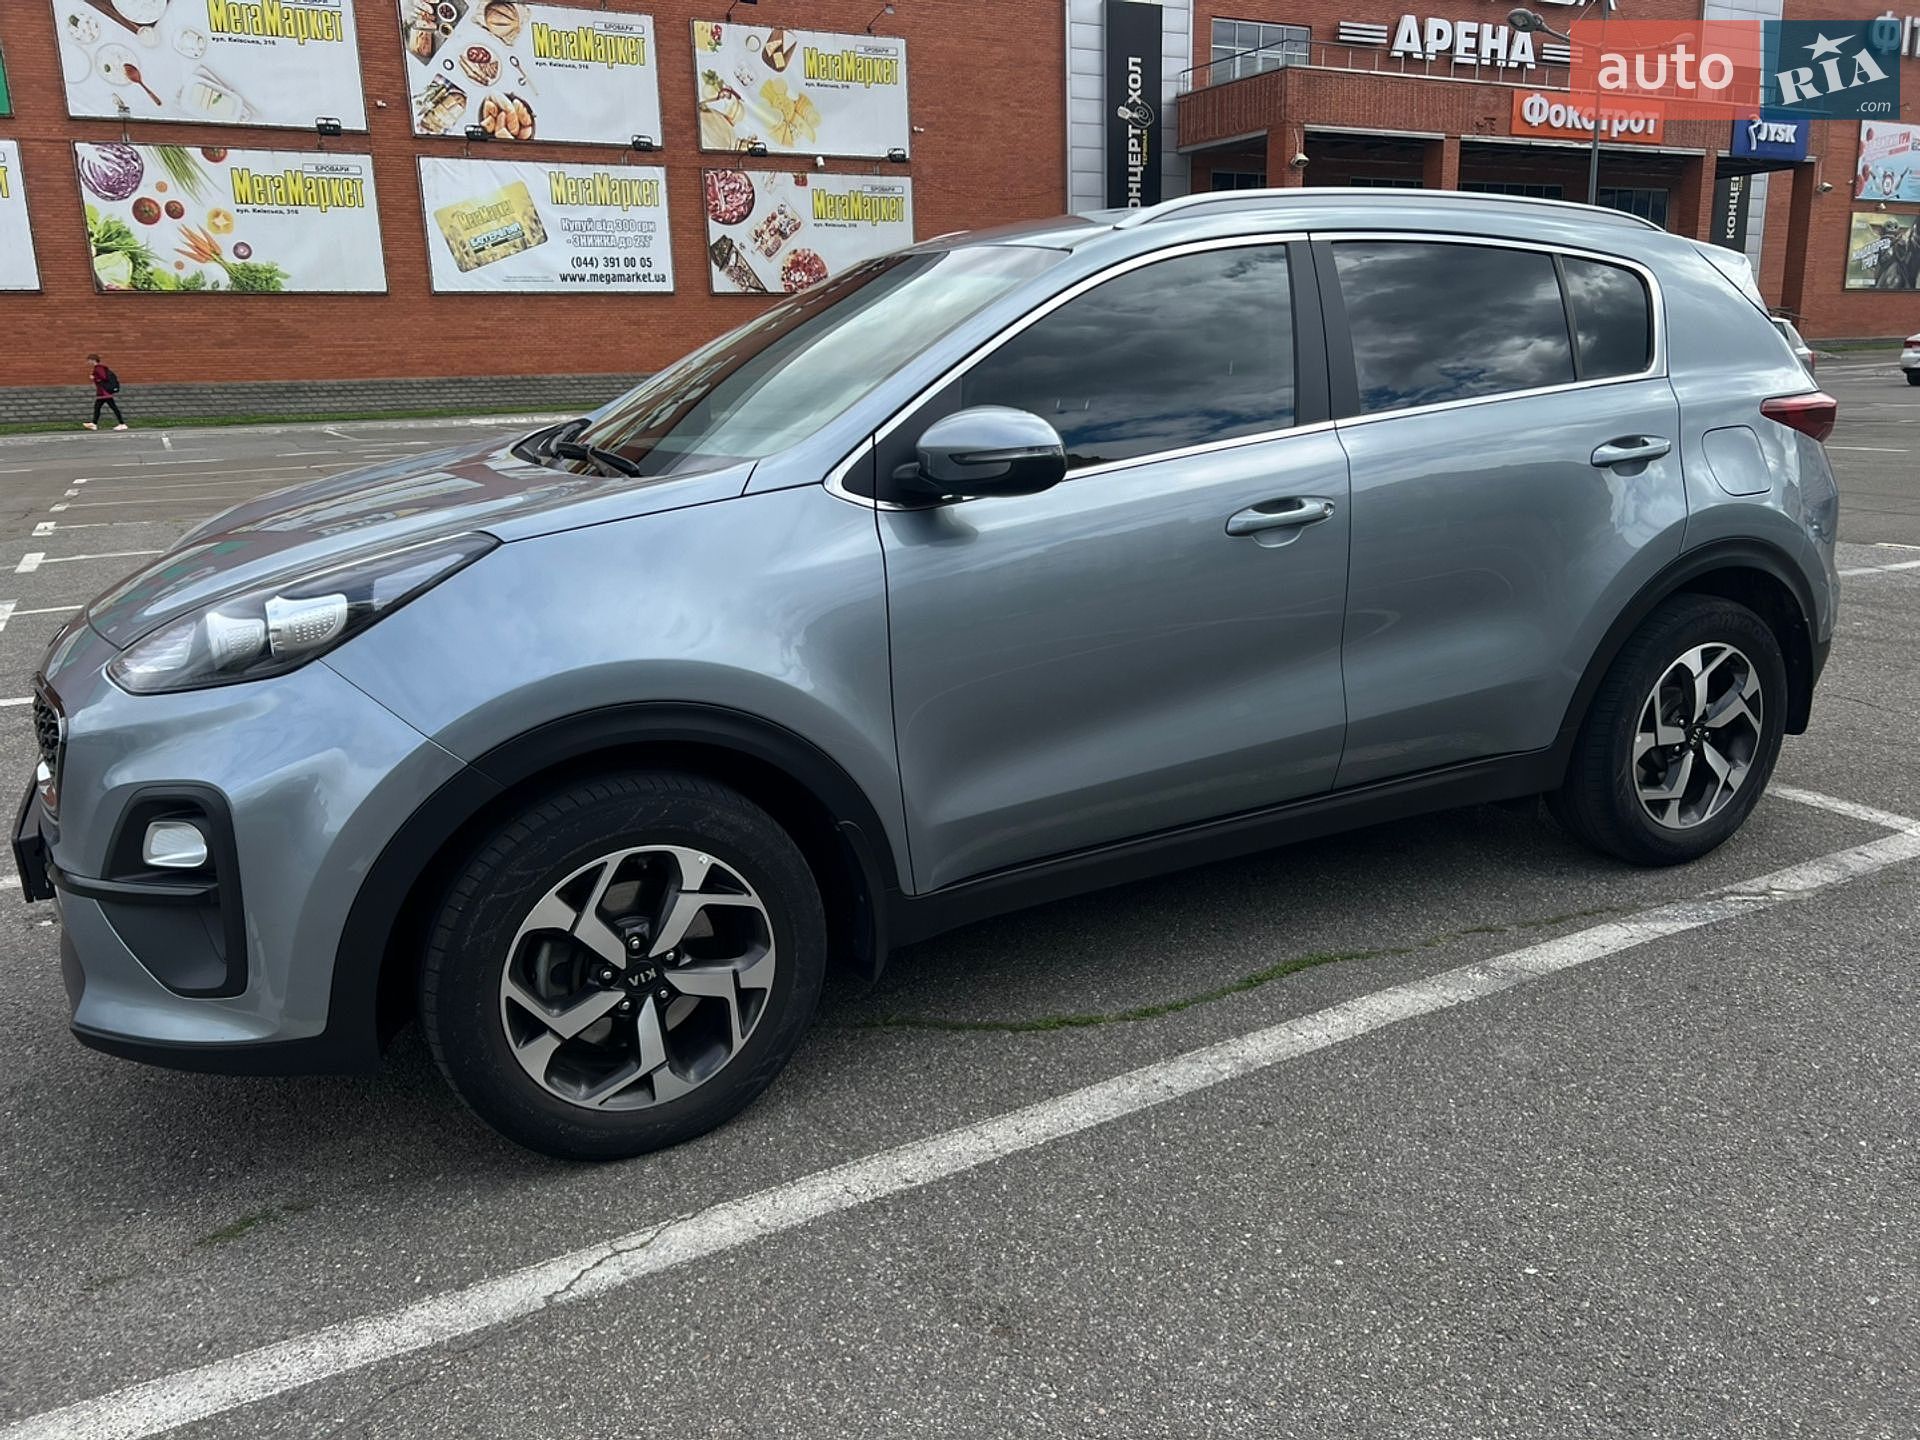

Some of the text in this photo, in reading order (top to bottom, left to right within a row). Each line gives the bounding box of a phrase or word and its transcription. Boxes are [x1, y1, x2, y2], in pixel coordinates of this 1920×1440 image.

[207, 0, 343, 45] МегаМаркет
[1390, 14, 1536, 70] АРЕНА
[531, 22, 646, 70] МегаМаркет
[803, 47, 899, 89] МегаМаркет
[1127, 56, 1144, 209] ОНЦЕРТ ХОЛ
[1522, 93, 1660, 138] Фокстрот
[1759, 122, 1799, 144] JYSK
[230, 167, 365, 213] МегаМаркет
[549, 170, 660, 212] МегаМаркет
[812, 188, 904, 227] МегаМаркет
[561, 217, 594, 233] Купуй
[615, 218, 636, 233] 300
[559, 272, 667, 285] www.megamarket.ua
[570, 256, 653, 269] (044) 391 00 05
[628, 967, 657, 987] KIA
